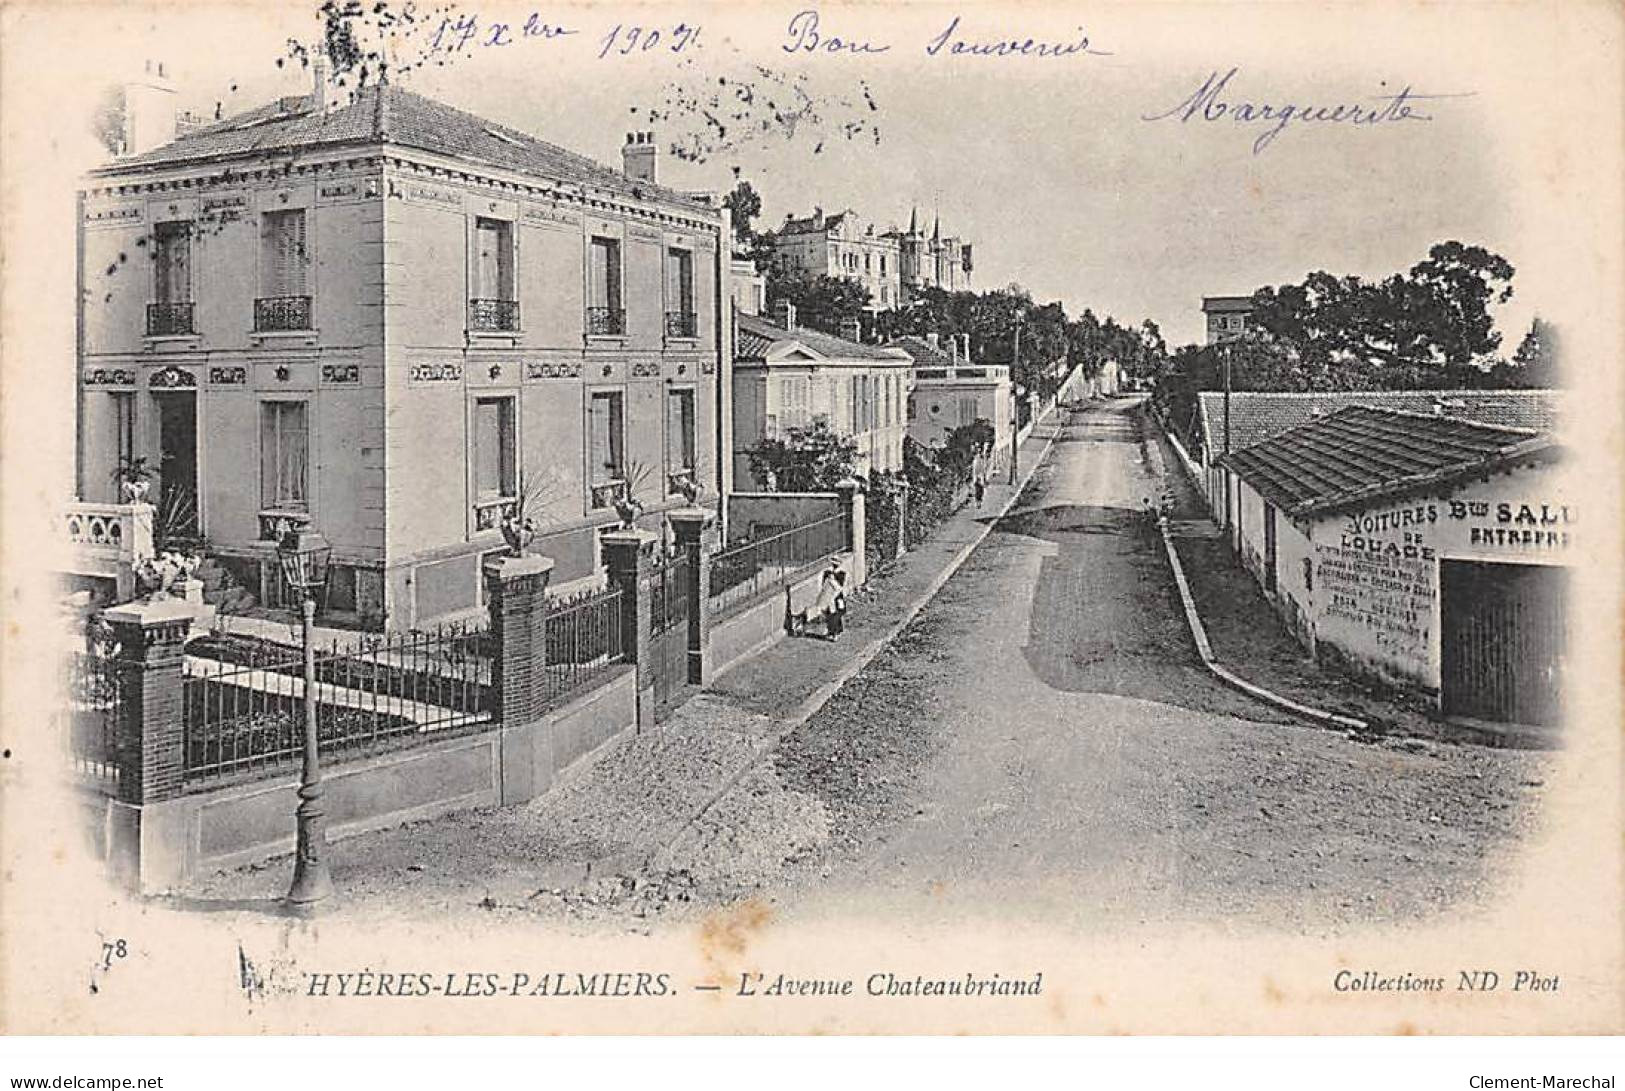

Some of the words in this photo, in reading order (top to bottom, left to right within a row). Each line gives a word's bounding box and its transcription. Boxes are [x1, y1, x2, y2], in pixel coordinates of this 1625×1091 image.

[783, 11, 889, 53] Bon
[1141, 67, 1475, 155] Marguerite
[1346, 505, 1437, 534] VOITURES
[1341, 534, 1435, 561] LOUAGE
[305, 969, 678, 997] HYÈRES-LES-PALMIERS.
[737, 972, 853, 996] L'Avenue
[867, 972, 1043, 996] Chateaubriand
[1333, 970, 1445, 992] Collections
[1457, 971, 1499, 992] ND
